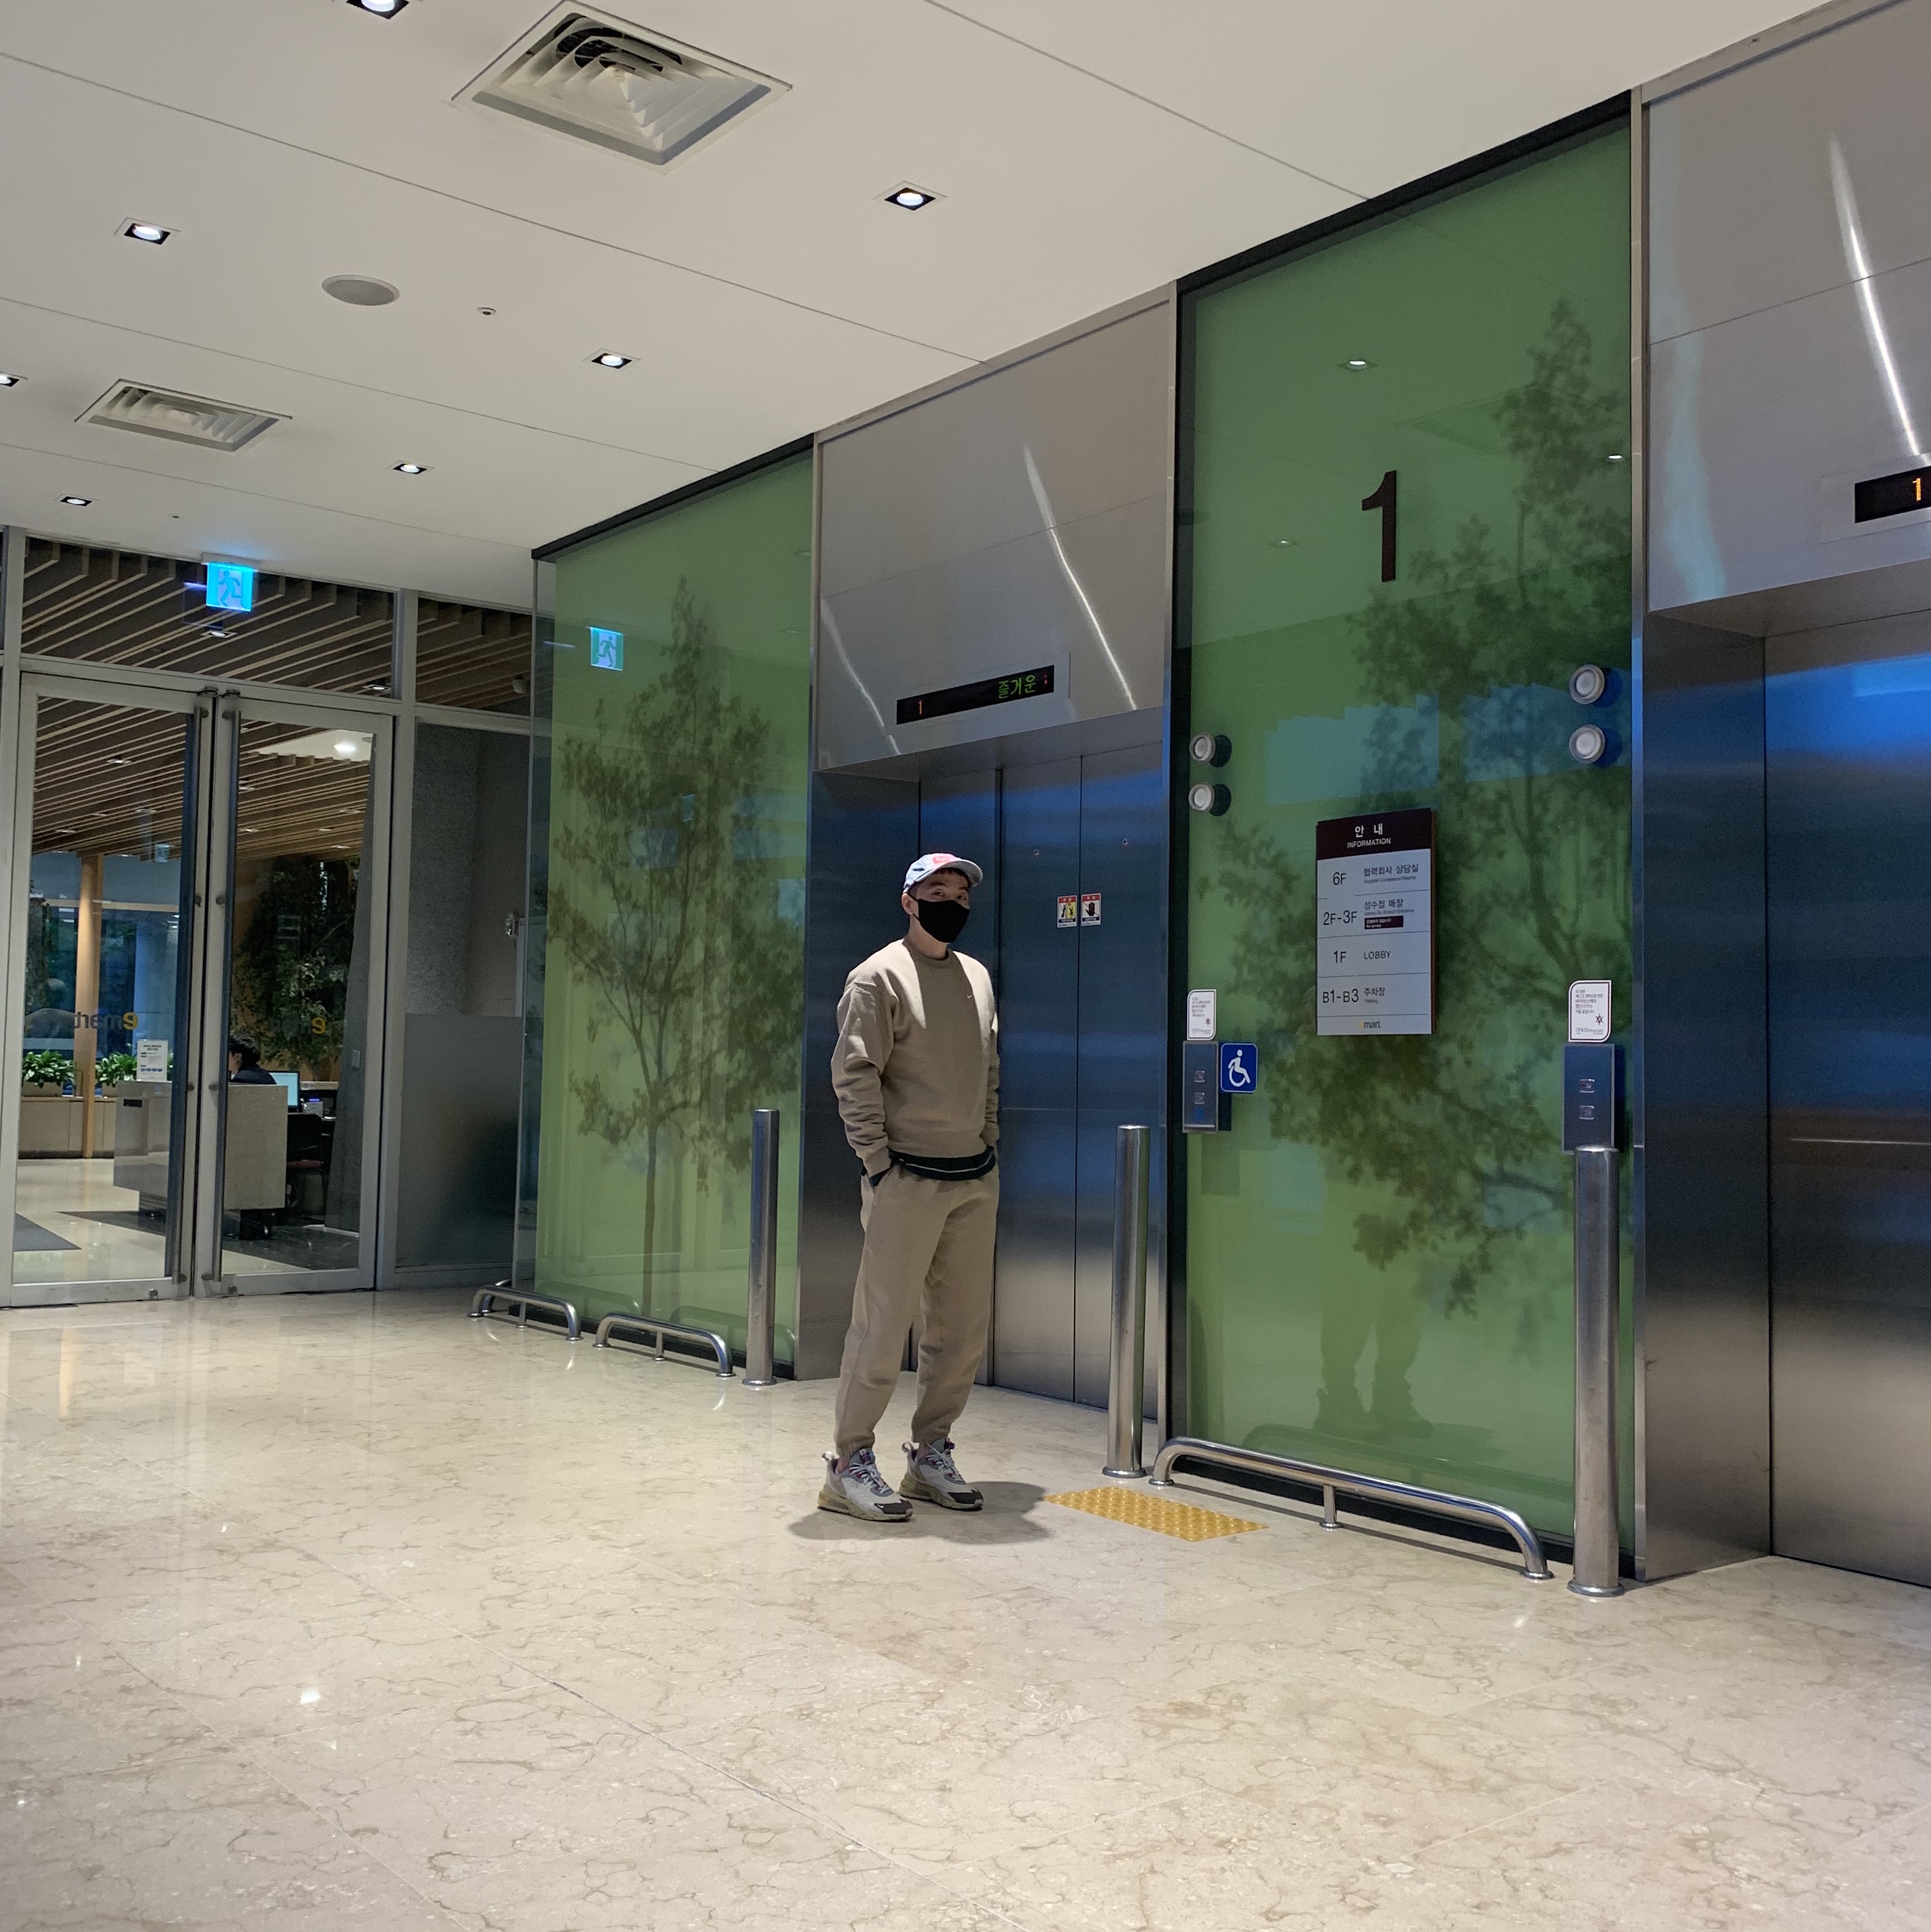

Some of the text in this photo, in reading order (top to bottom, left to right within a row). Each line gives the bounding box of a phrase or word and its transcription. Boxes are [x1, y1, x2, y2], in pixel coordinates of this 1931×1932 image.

[1912, 478, 1921, 502] 1
[1361, 470, 1397, 582] 1
[998, 674, 1036, 699] 즐거운
[918, 700, 923, 715] 1
[1354, 823, 1383, 838] 안 내
[1347, 837, 1391, 849] INFORMATION
[1363, 863, 1419, 877] 협력회사 상담실
[1333, 872, 1347, 885] 6F
[1364, 899, 1404, 910] 성수점 매장
[1323, 909, 1358, 925] 2F-3F
[1333, 950, 1347, 963] 1F
[1363, 950, 1391, 960] LOBBY
[1322, 988, 1359, 1003] B1-B3
[1363, 987, 1386, 996] 주차장
